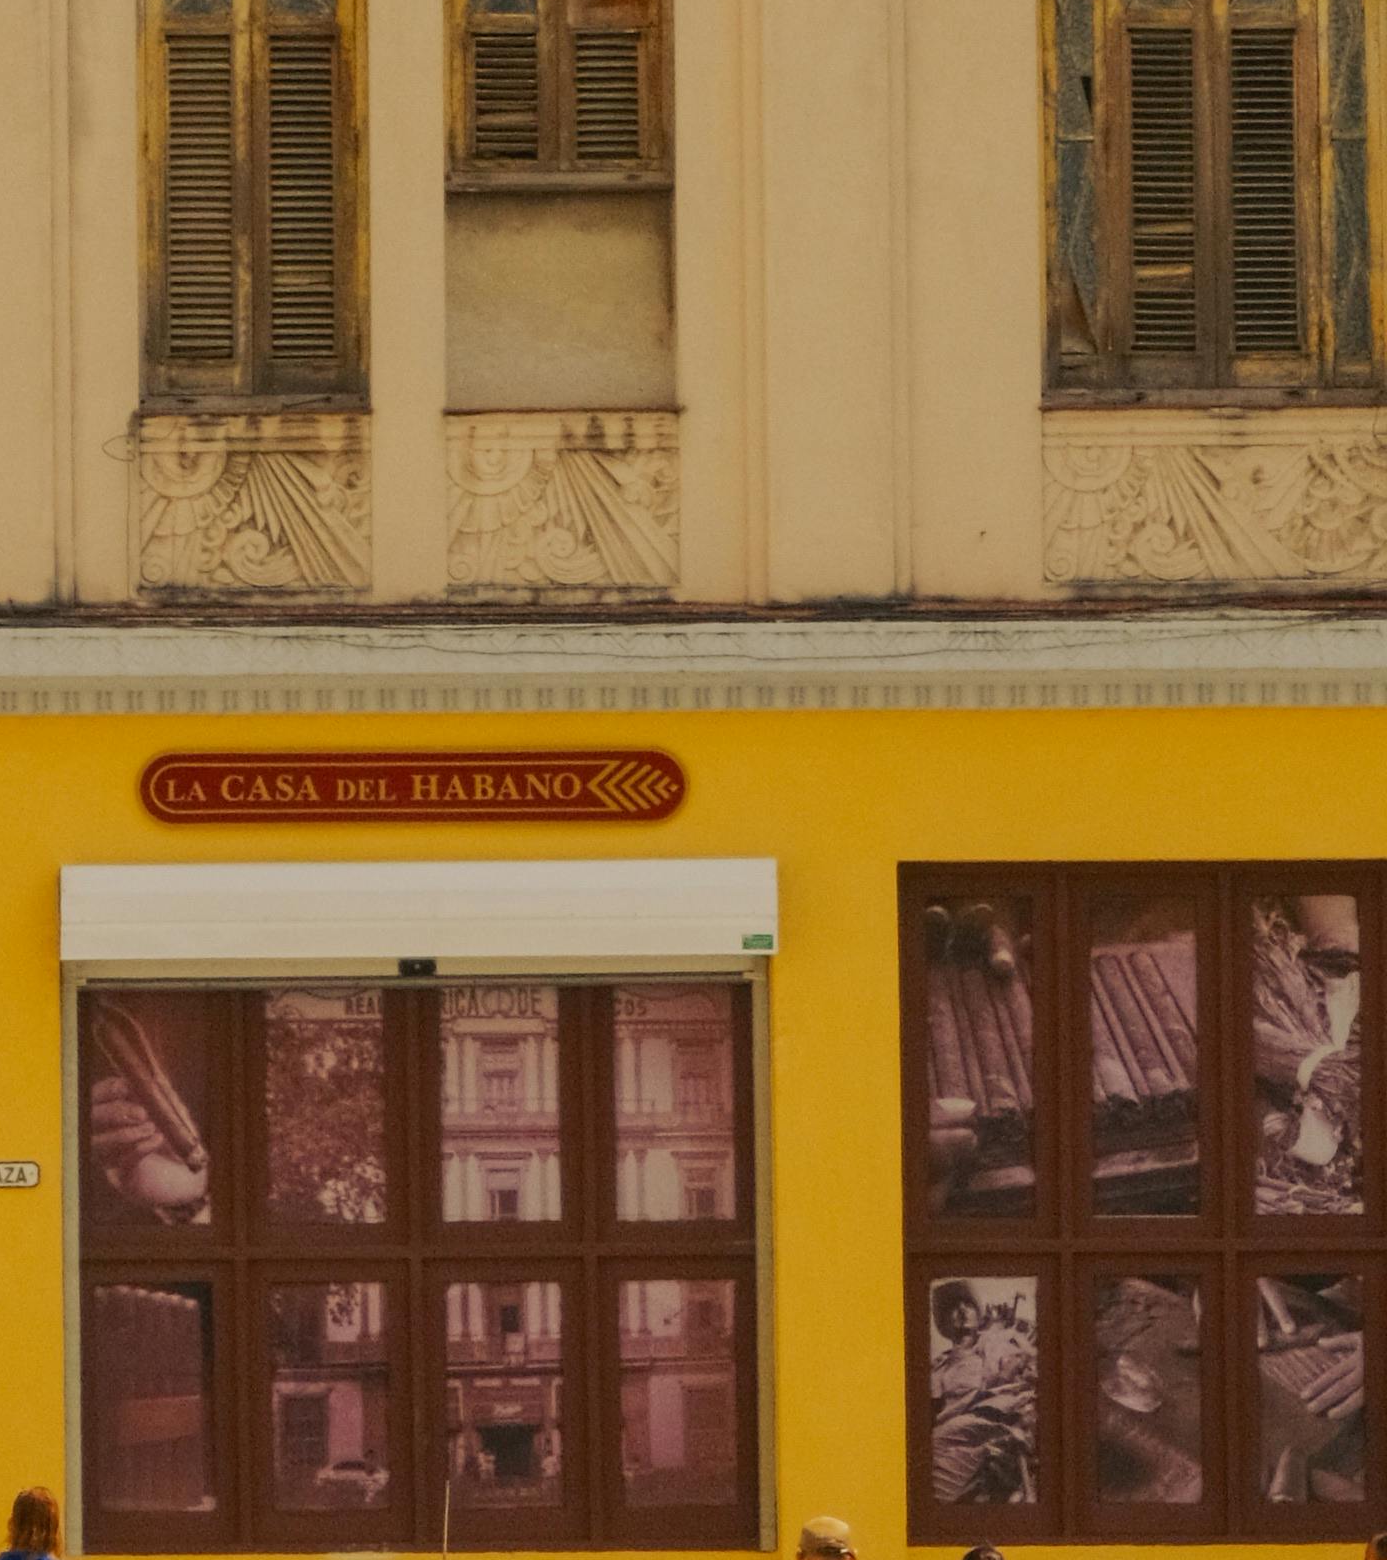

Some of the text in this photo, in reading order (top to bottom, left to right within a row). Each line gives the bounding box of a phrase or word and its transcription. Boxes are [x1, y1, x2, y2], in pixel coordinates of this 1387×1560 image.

[165, 772, 582, 802] LA CASA DEL HABANO
